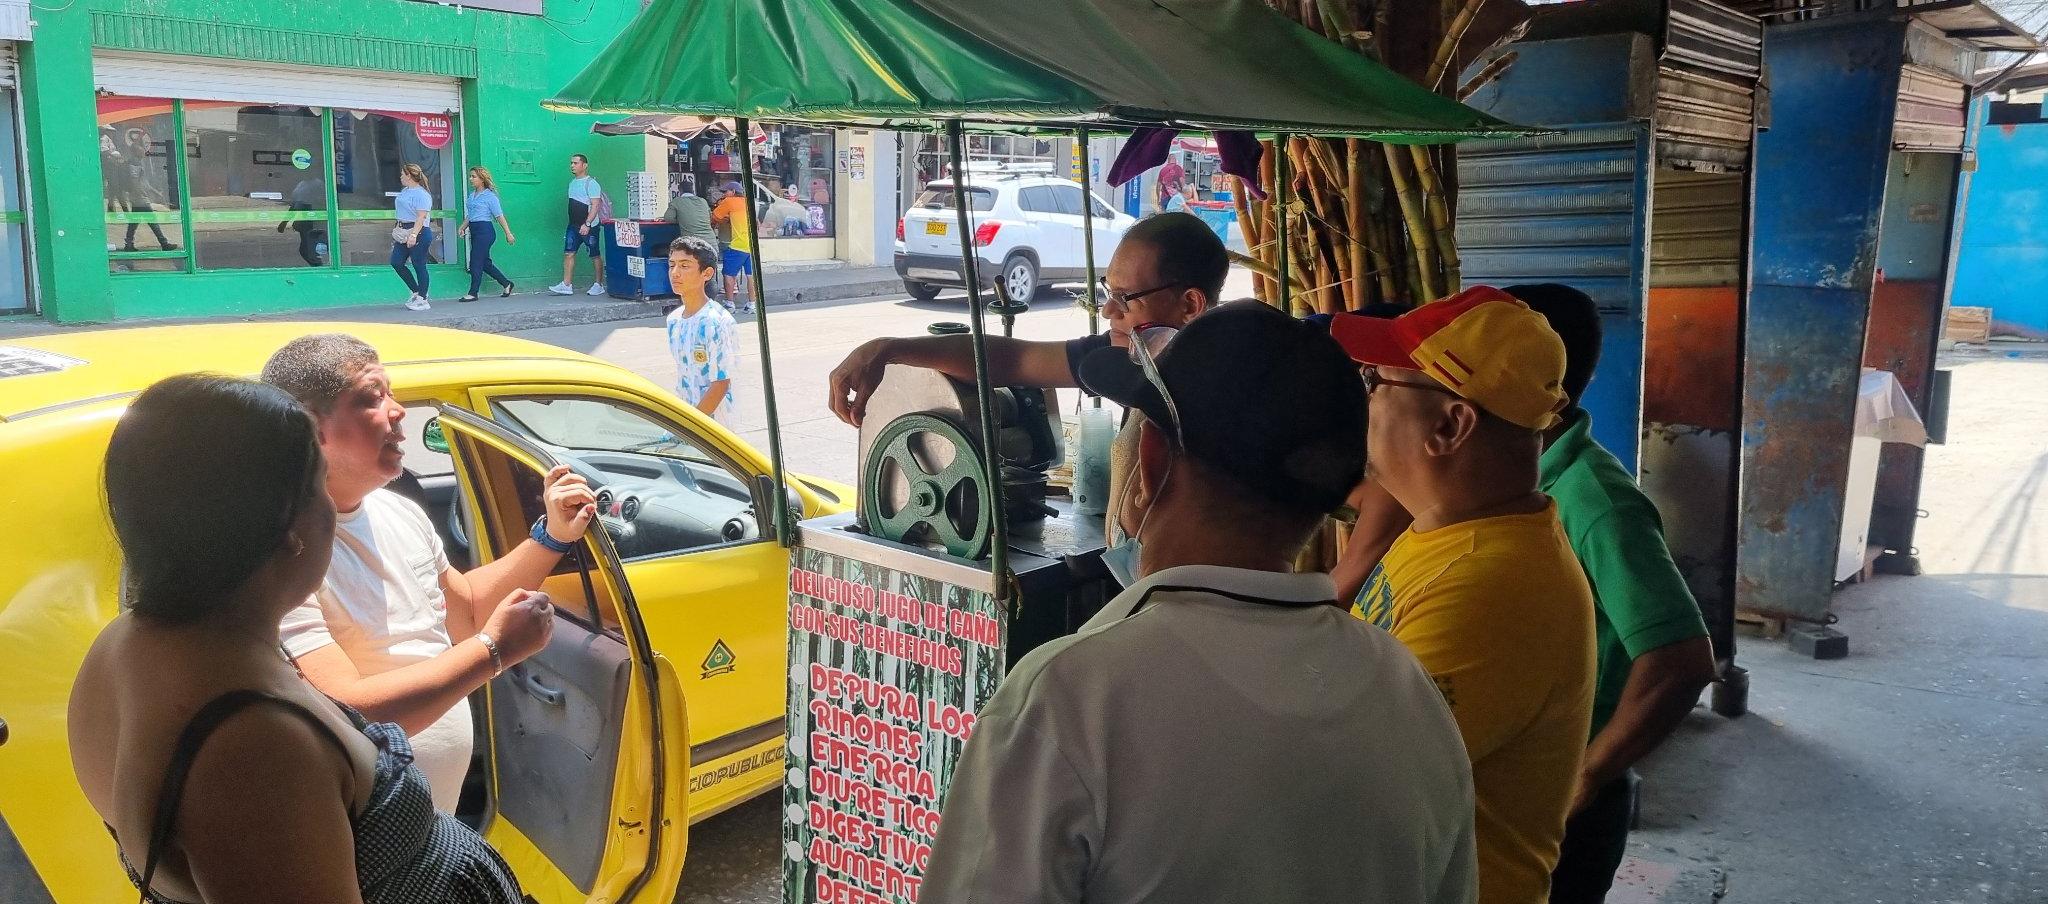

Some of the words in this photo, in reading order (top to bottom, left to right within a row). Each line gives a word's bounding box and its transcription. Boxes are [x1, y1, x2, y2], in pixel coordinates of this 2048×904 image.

[420, 116, 448, 128] Brilla
[616, 221, 636, 233] PILAS
[791, 567, 875, 614] DELICIOSO
[878, 589, 921, 626] JUGO
[924, 601, 947, 634] DE
[949, 608, 999, 649] CAÑA
[791, 602, 826, 636] CON
[828, 612, 860, 646] SUS
[863, 622, 962, 677] BENEFICIOS
[809, 662, 921, 724] DEPURA
[927, 699, 977, 741] LOS
[808, 765, 941, 840] DIURETICO
[809, 731, 936, 801] ENERGIA
[808, 801, 932, 874] DIGESTIVO
